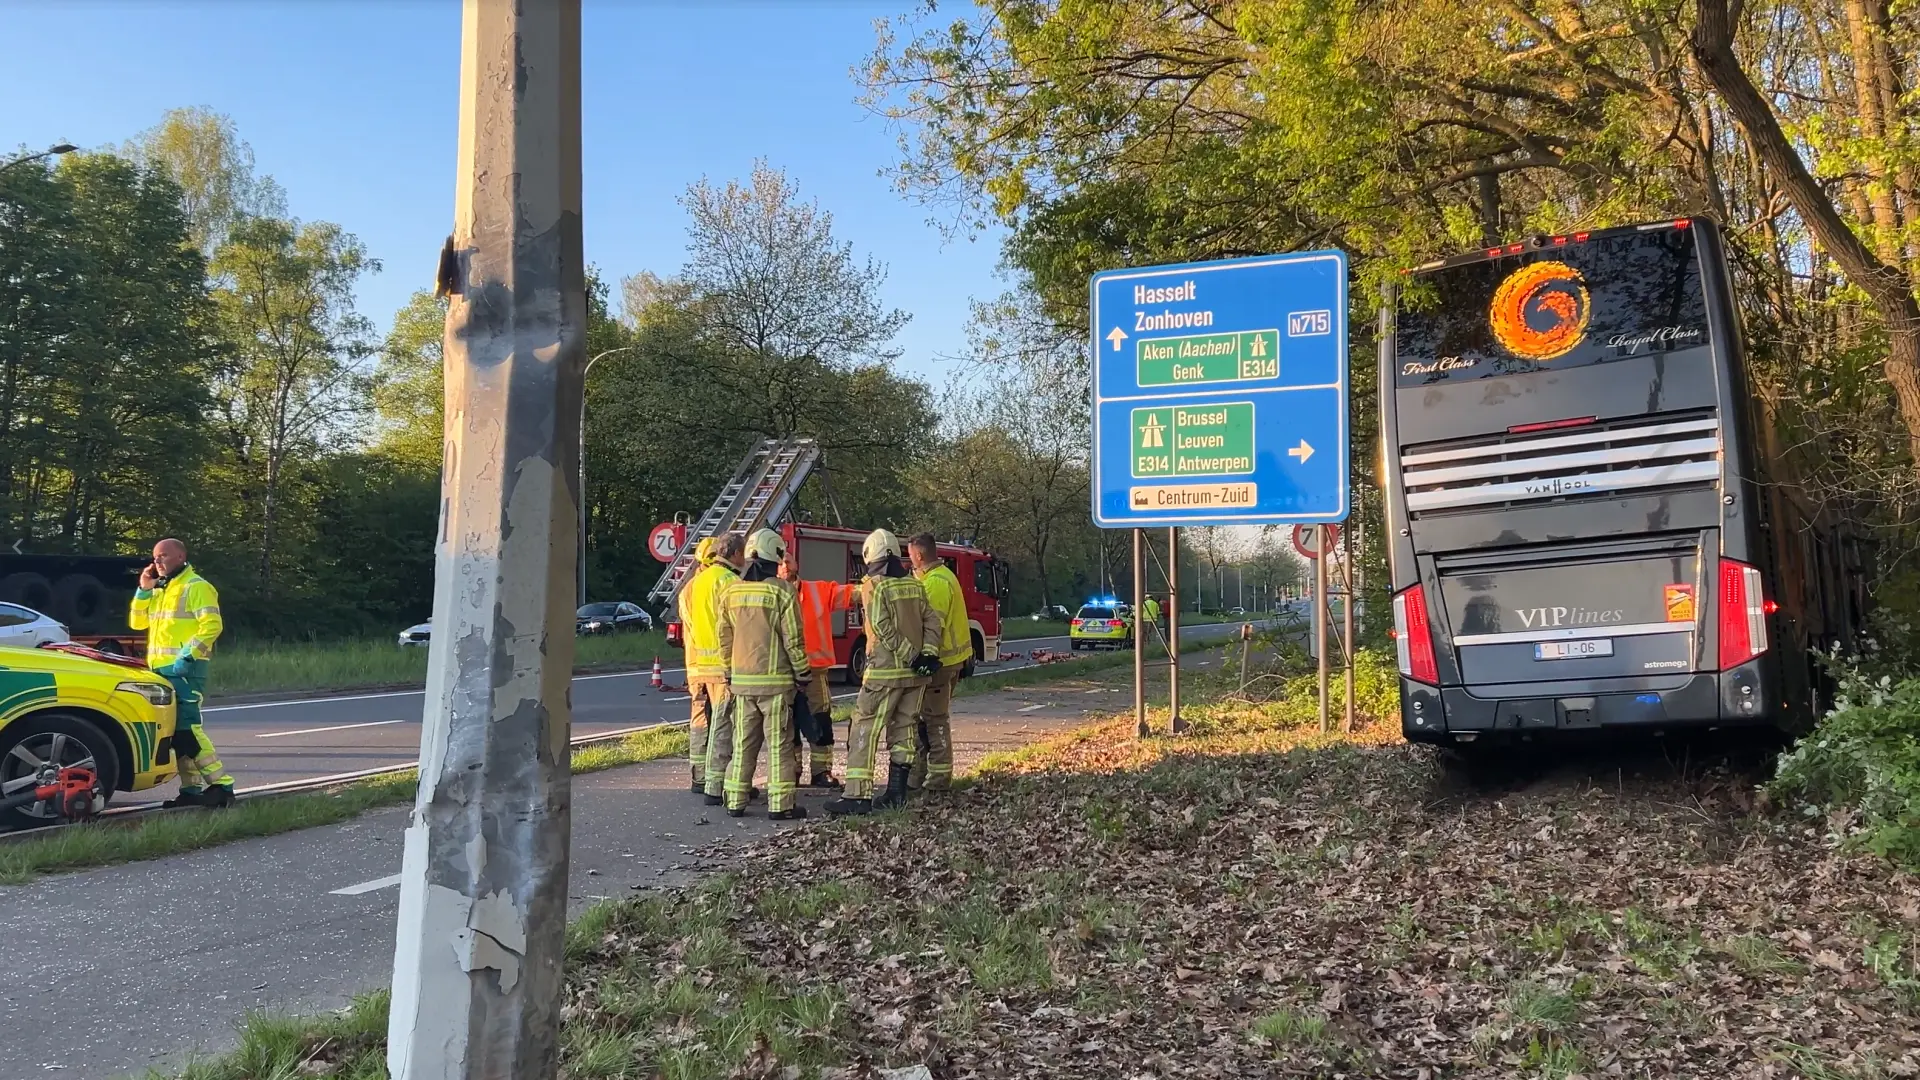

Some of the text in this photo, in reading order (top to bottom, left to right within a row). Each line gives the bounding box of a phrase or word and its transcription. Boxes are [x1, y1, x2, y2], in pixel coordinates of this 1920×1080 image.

[1134, 281, 1196, 304] Hasselt
[1135, 310, 1213, 331] Zonhoven
[1291, 313, 1327, 333] N715
[1143, 338, 1236, 360] Aken (Aachen)
[1605, 325, 1700, 355] Royal Class
[1173, 363, 1204, 380] Genk
[1243, 360, 1276, 378] E314
[1401, 356, 1474, 376] First Class
[1178, 409, 1227, 427] Brussel
[1178, 434, 1224, 449] Leuven
[1138, 455, 1169, 472] E314
[1177, 455, 1249, 473] Antwerpen
[1157, 487, 1249, 505] Centrum-Zuid
[1644, 660, 1688, 669] astromega
